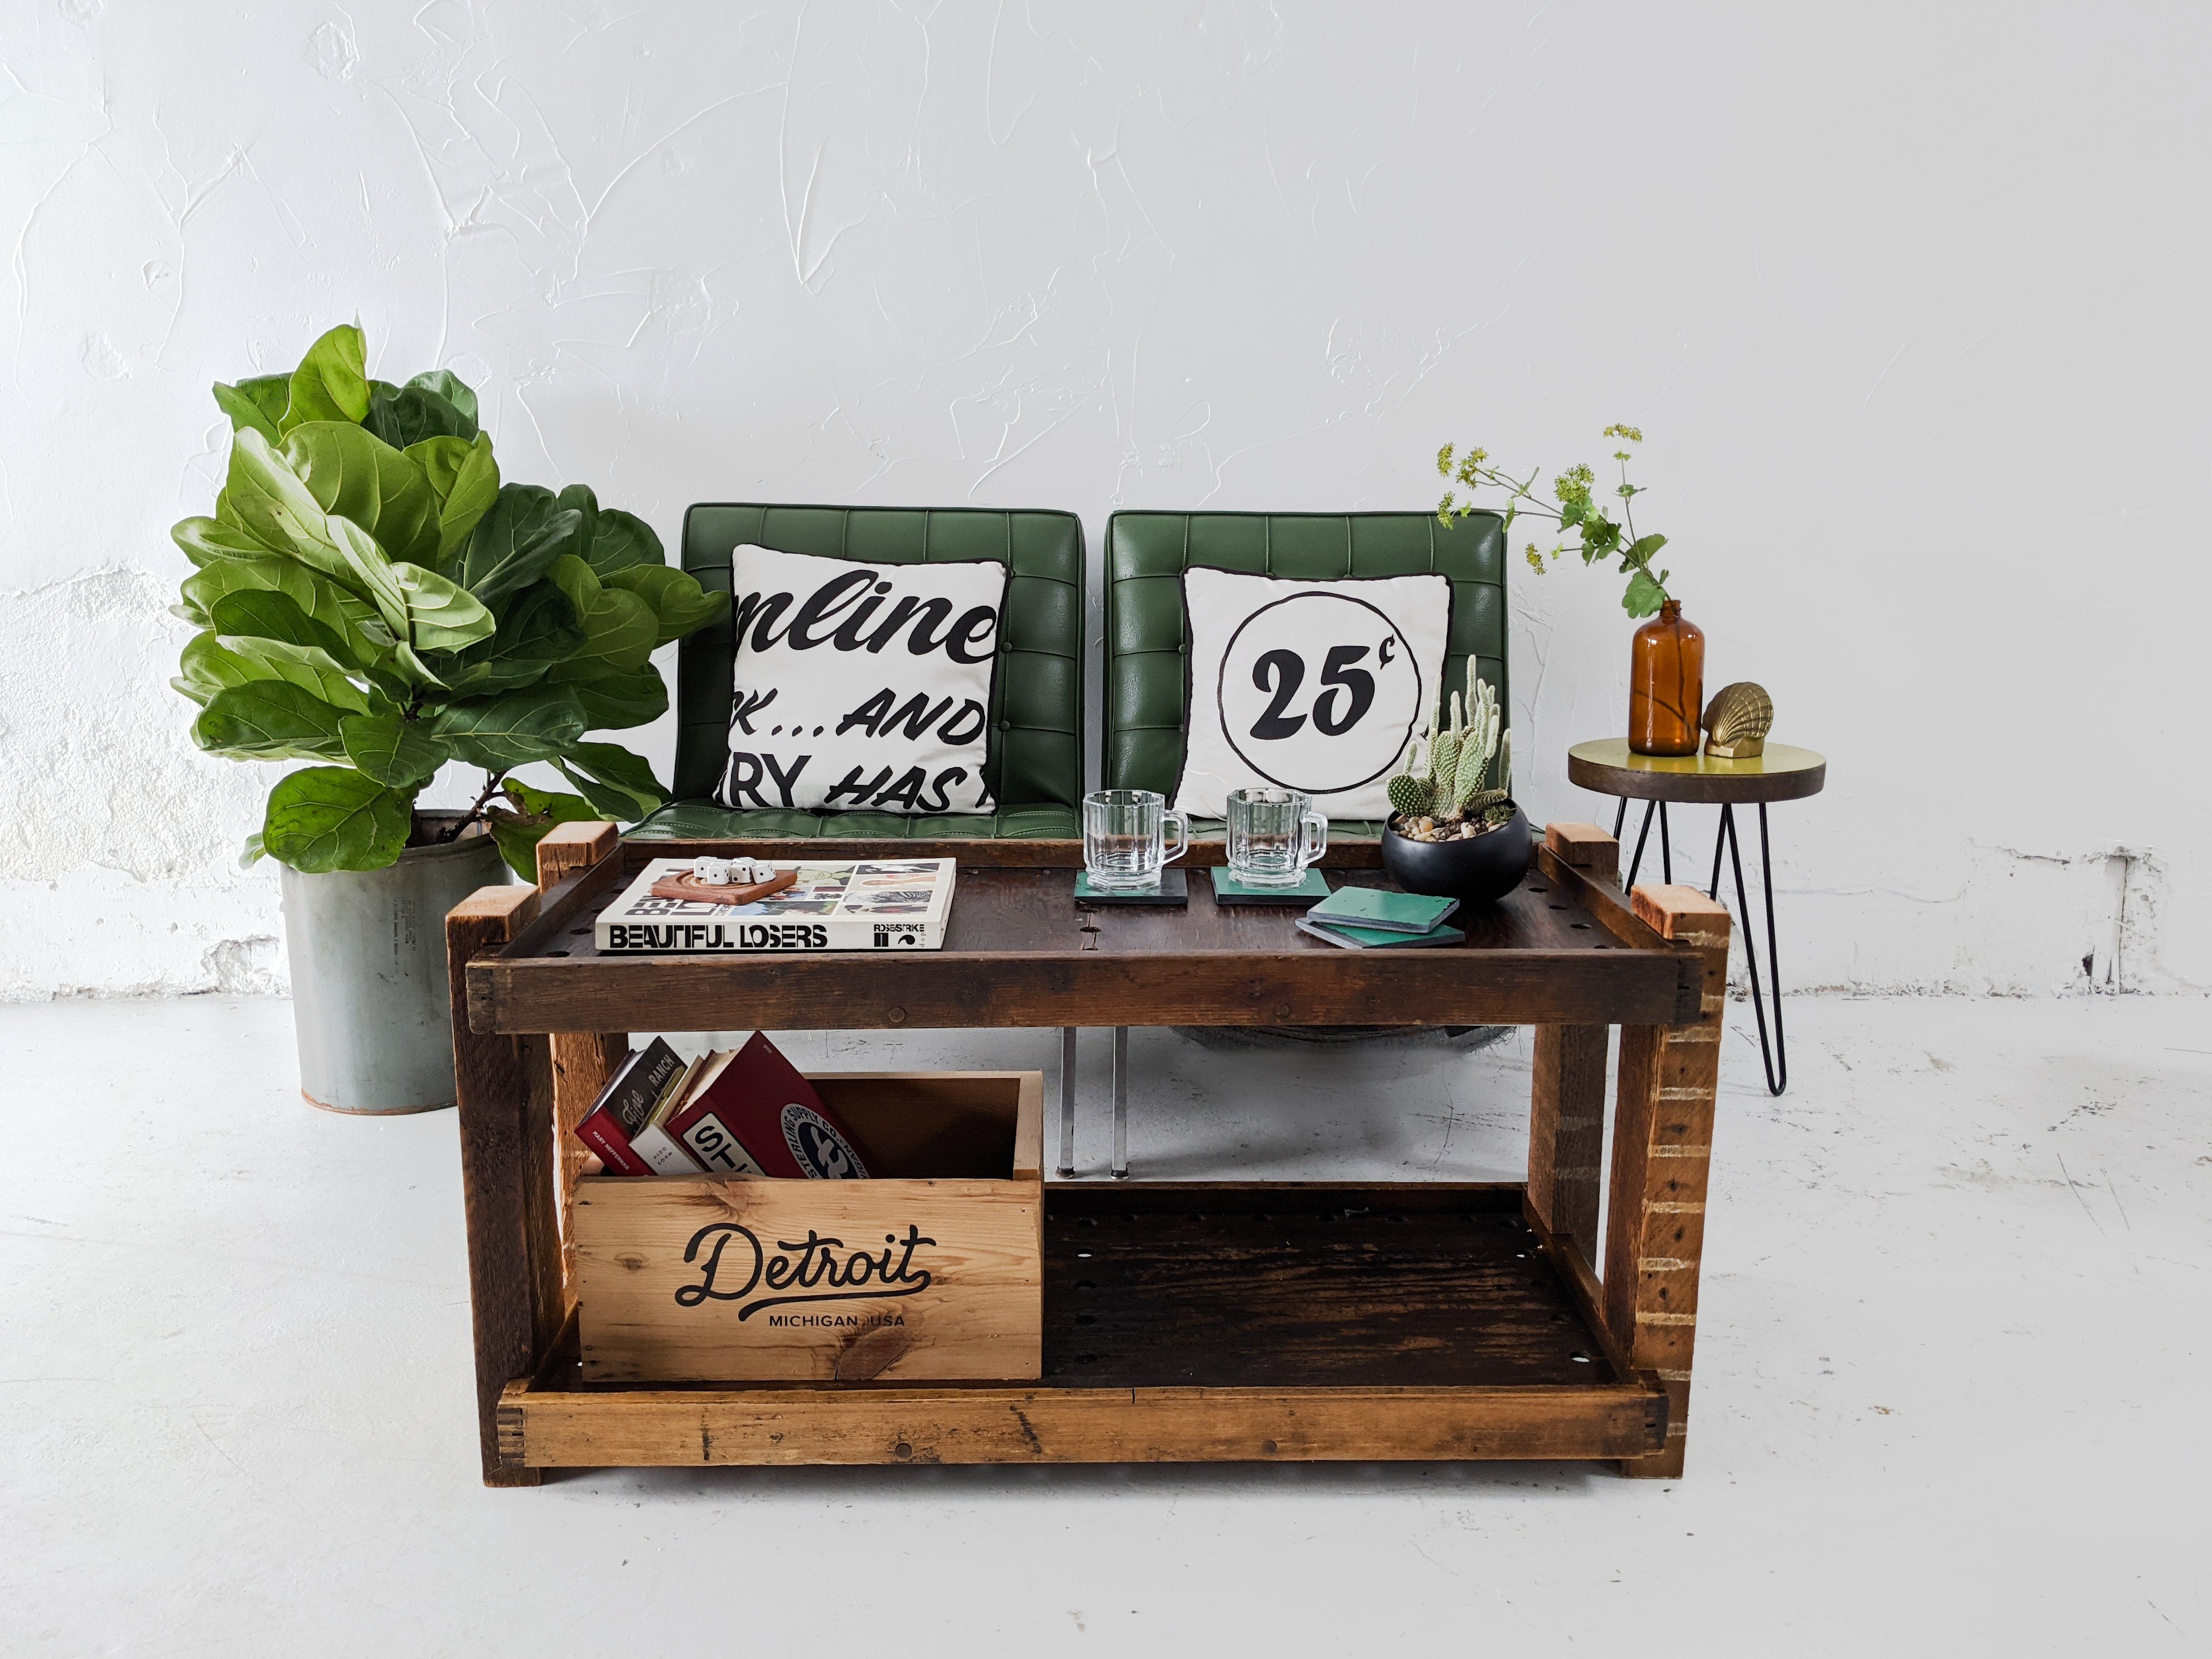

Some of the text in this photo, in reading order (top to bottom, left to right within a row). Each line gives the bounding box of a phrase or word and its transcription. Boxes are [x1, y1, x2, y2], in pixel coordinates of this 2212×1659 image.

[824, 764, 969, 812] HAS
[609, 924, 828, 948] BEAUTIFUL LOSERS
[648, 1054, 675, 1086] RANCH
[787, 1107, 819, 1124] SUPPLY
[592, 1130, 630, 1171] MARY HEFFERNAN
[654, 1147, 667, 1160] ALDO
[784, 1115, 817, 1178] STERLING
[675, 1223, 937, 1322] Detroit
[769, 1314, 905, 1327] MICHIGAN USA
